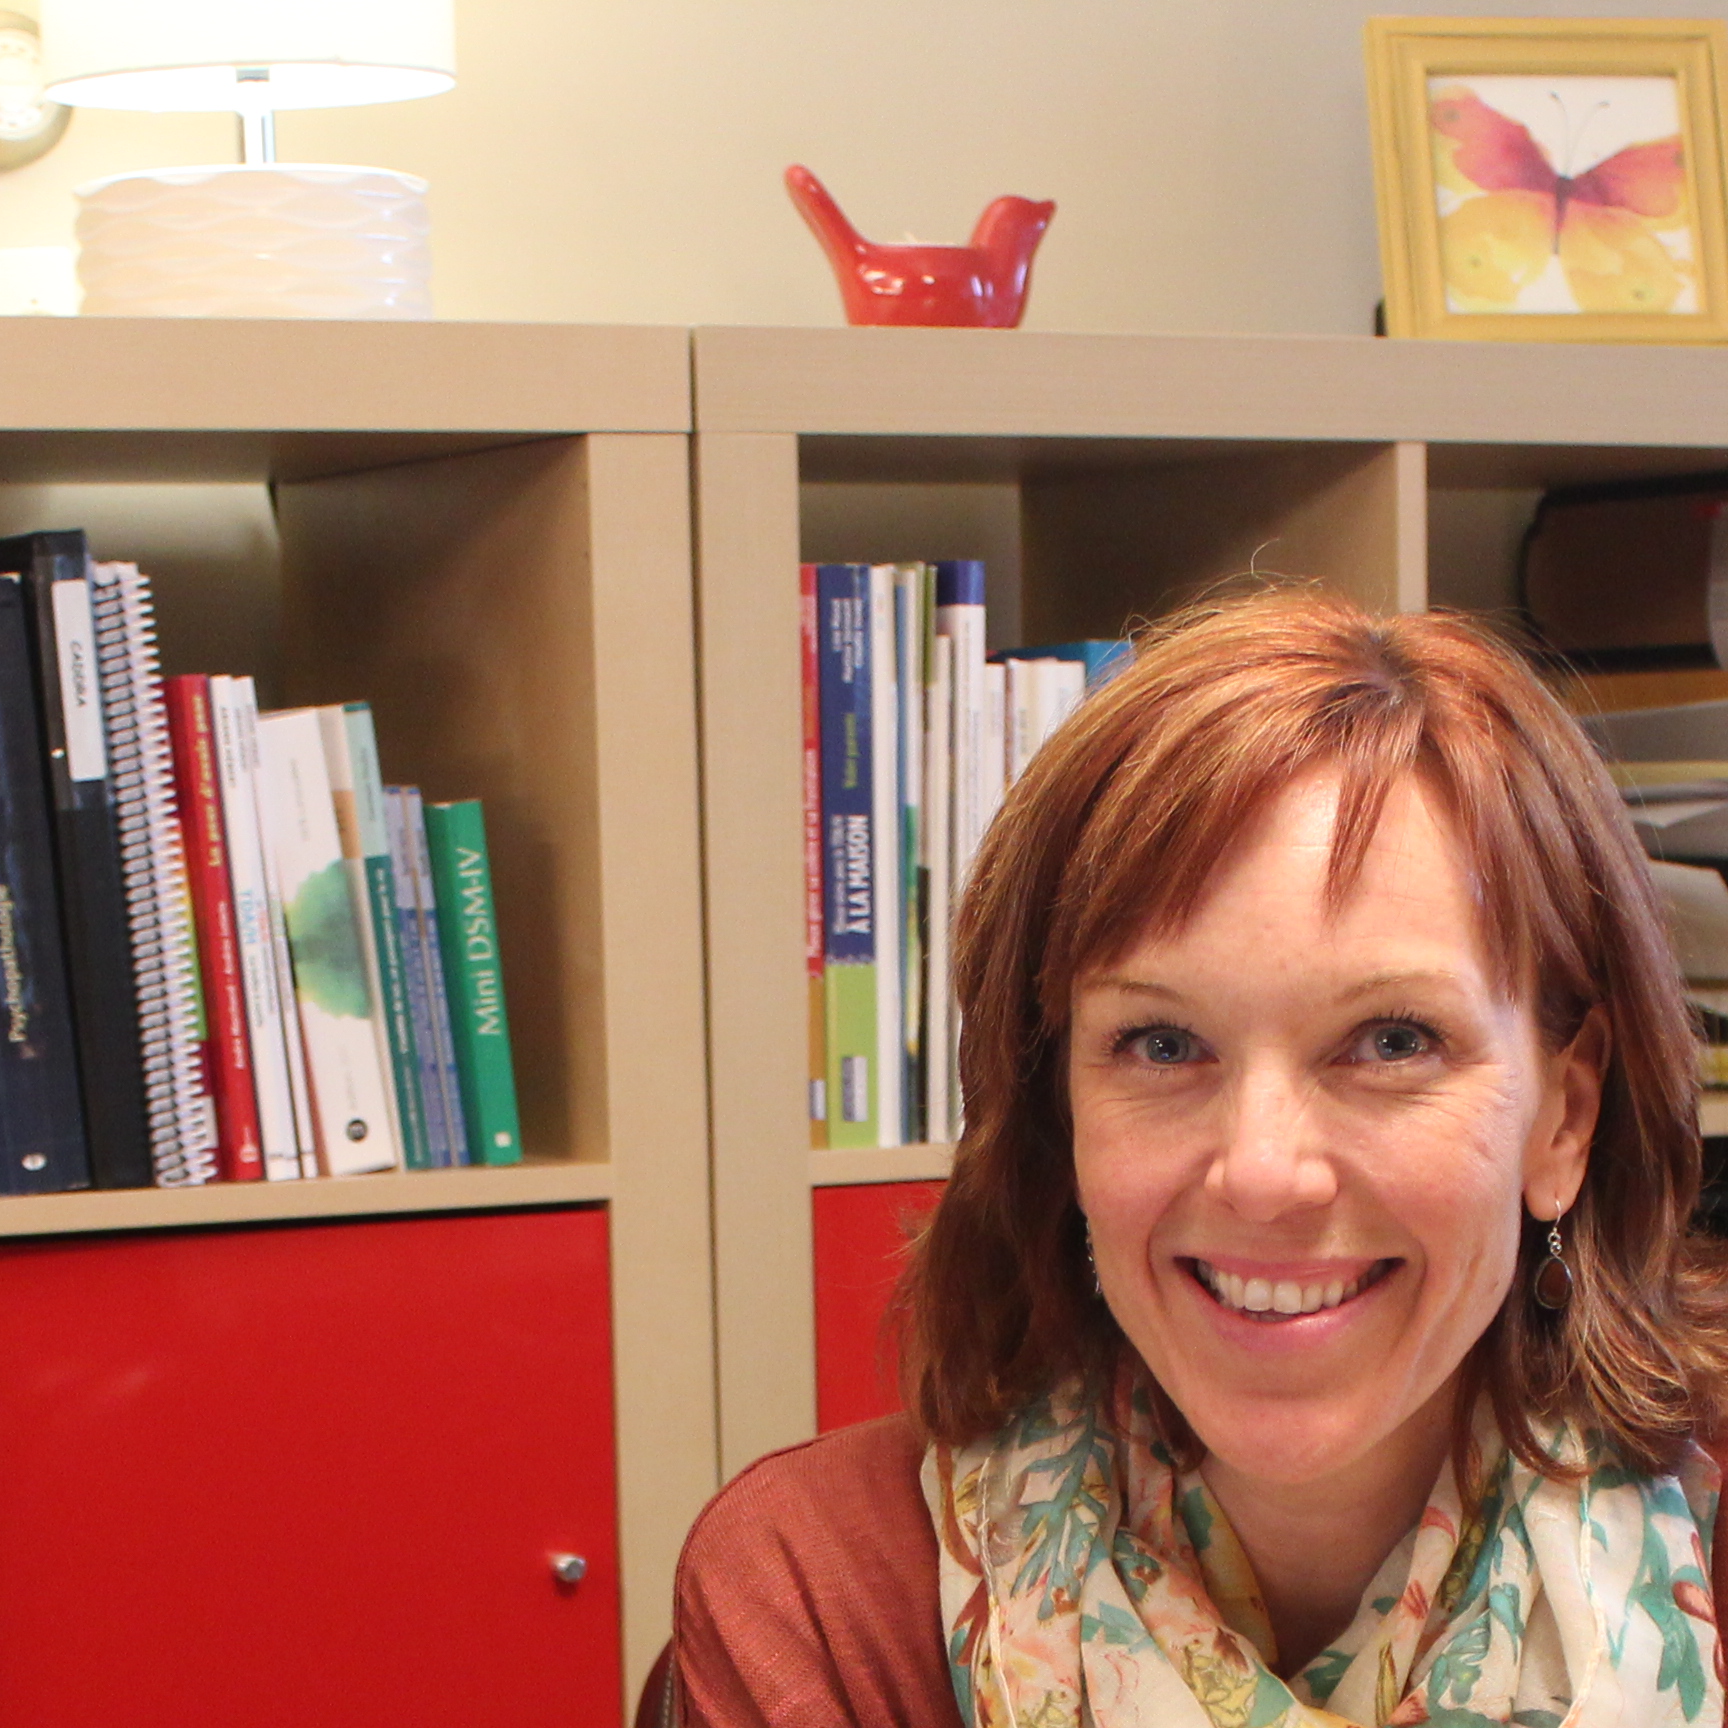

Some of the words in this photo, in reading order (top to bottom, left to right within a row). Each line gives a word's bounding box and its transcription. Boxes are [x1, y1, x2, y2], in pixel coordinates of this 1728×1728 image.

[846, 814, 871, 889] MAISON
[238, 889, 257, 945] TDA/H
[455, 846, 494, 962] DSM-IV
[847, 889, 871, 918] LA
[471, 968, 502, 1036] Mini
